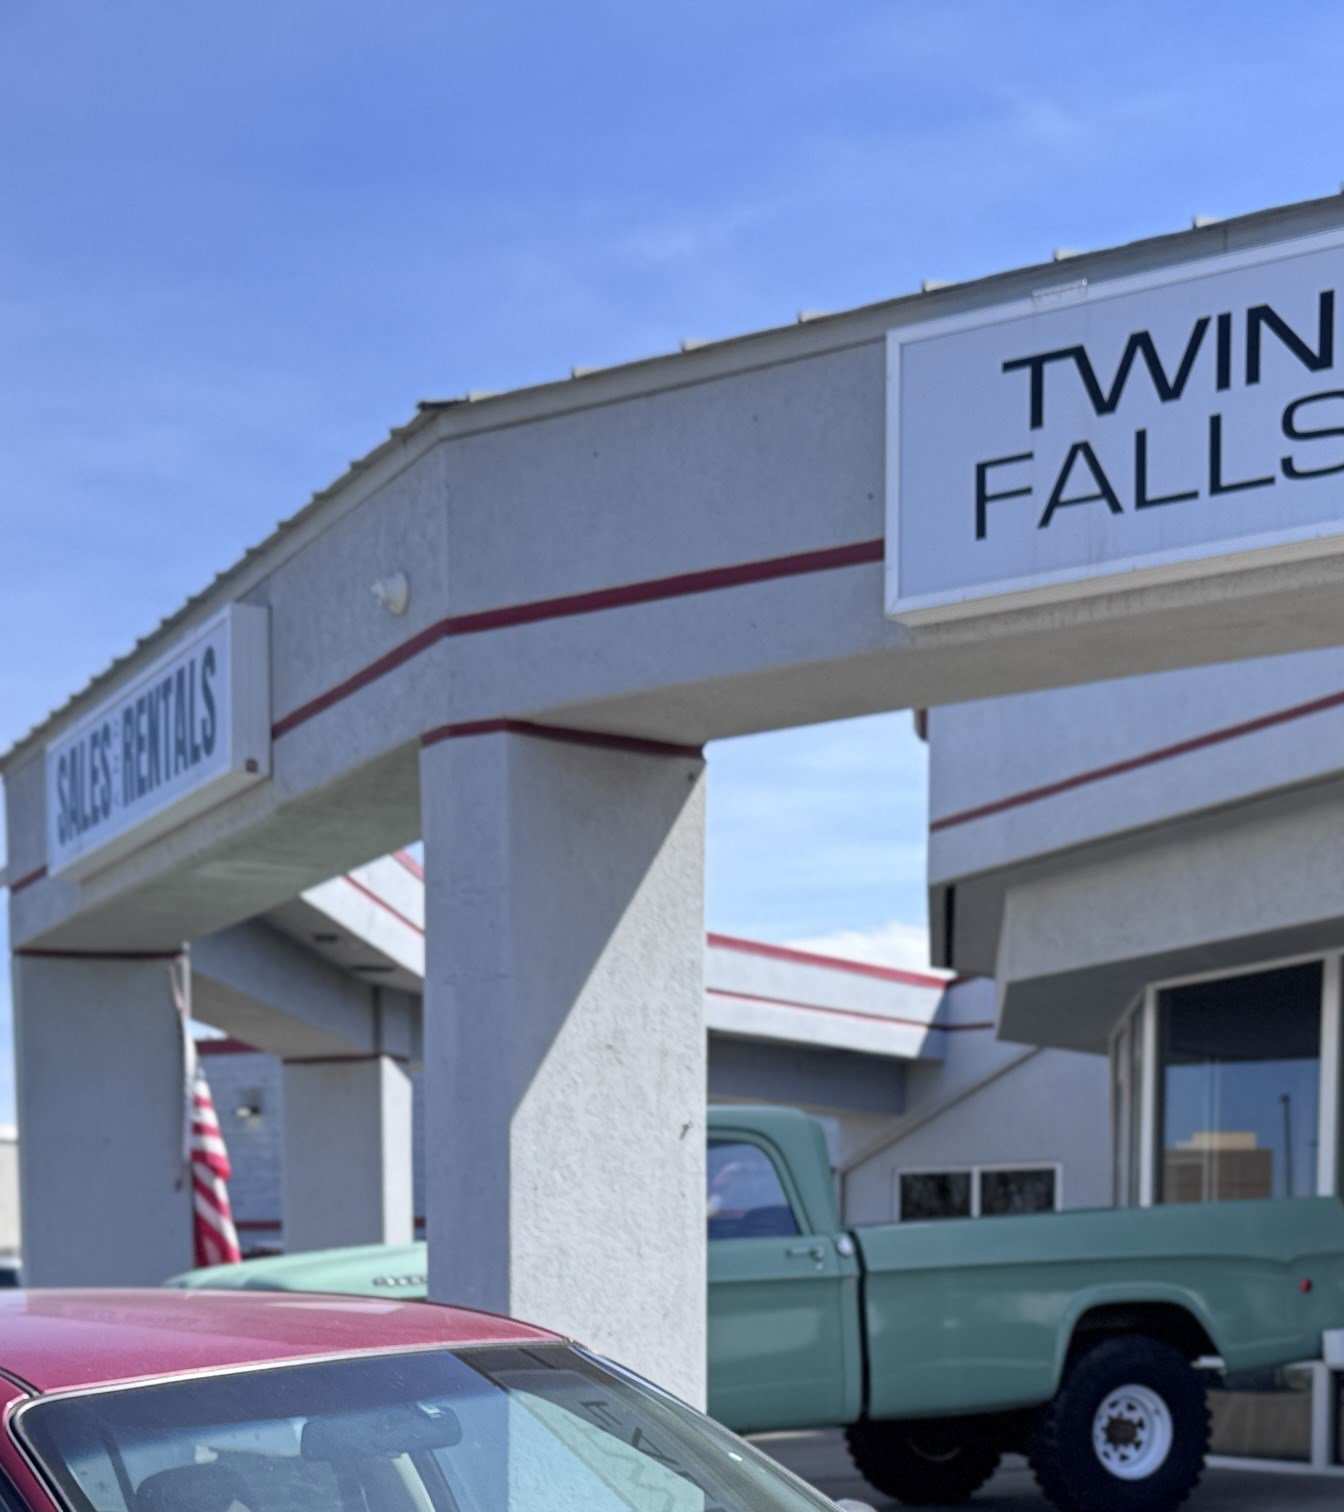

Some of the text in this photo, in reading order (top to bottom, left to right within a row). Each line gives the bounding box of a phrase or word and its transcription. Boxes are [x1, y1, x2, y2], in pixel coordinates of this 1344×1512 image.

[1002, 290, 1335, 430] TWIN
[58, 722, 113, 847] SALES
[123, 646, 217, 808] RENTALS
